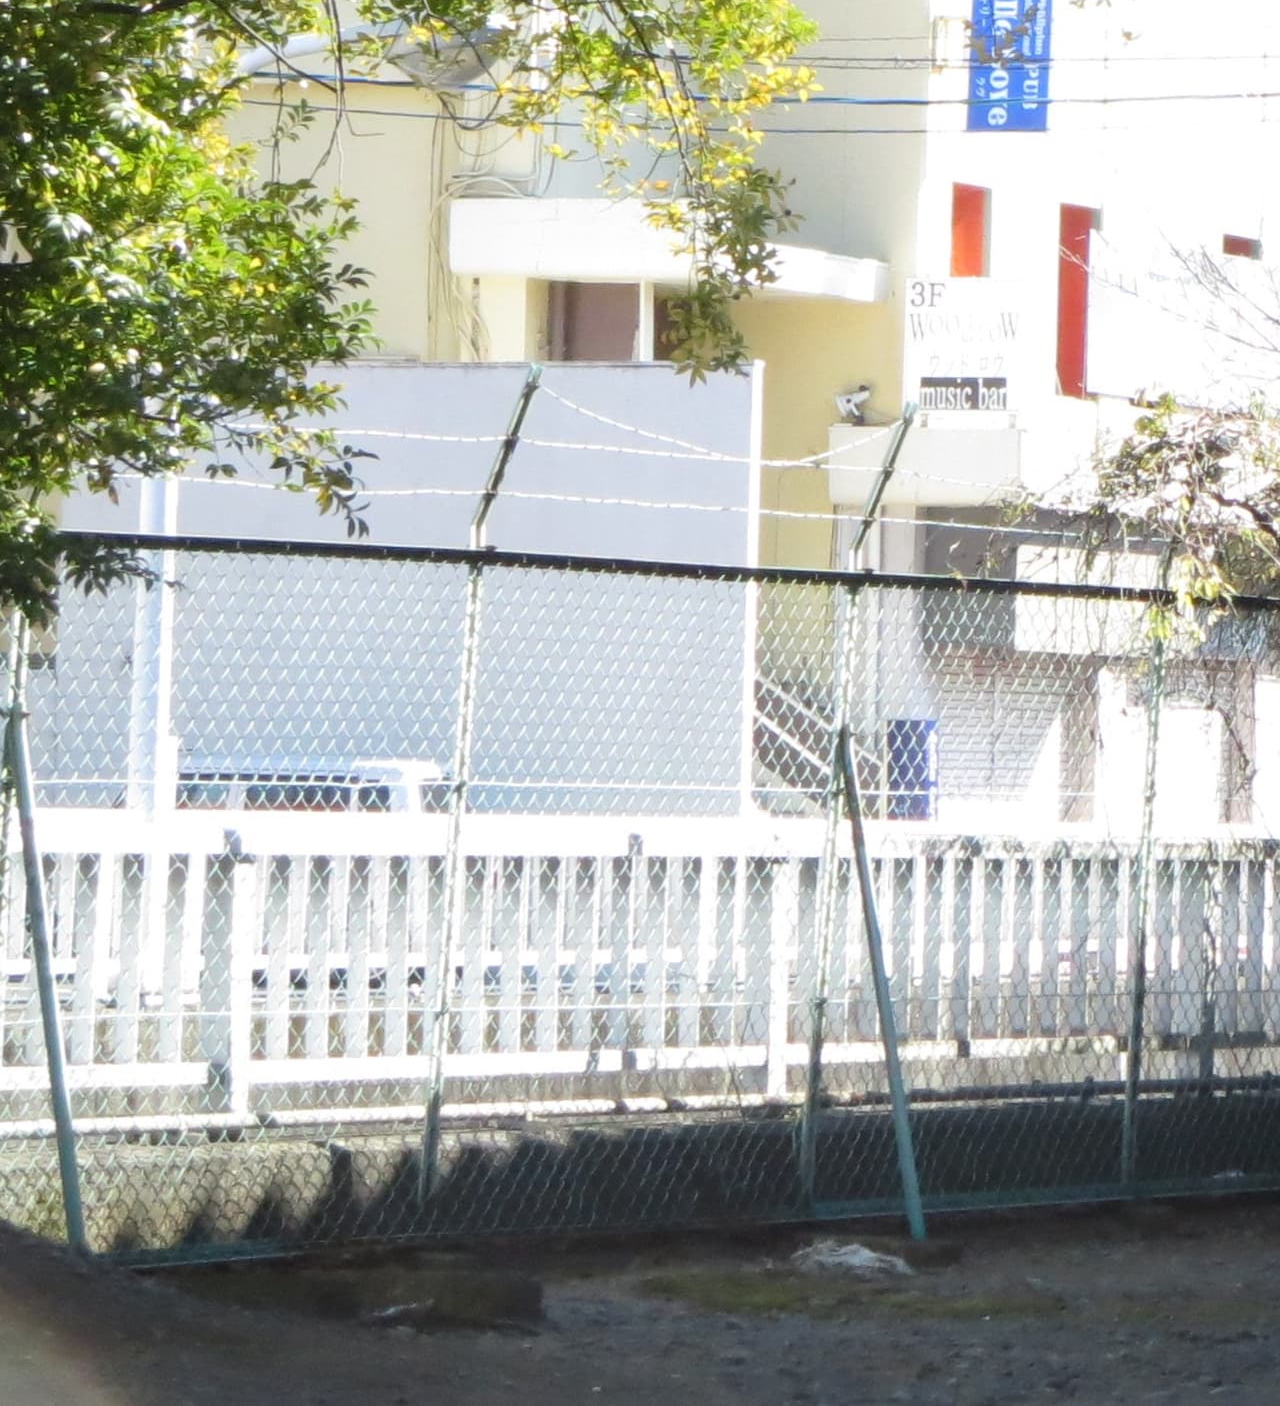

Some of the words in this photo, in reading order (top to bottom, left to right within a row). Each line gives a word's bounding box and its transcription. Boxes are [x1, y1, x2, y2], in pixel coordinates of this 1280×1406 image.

[1022, 63, 1039, 110] PUB
[910, 281, 946, 308] 3F
[920, 378, 973, 410] music
[978, 377, 1008, 410] bar
